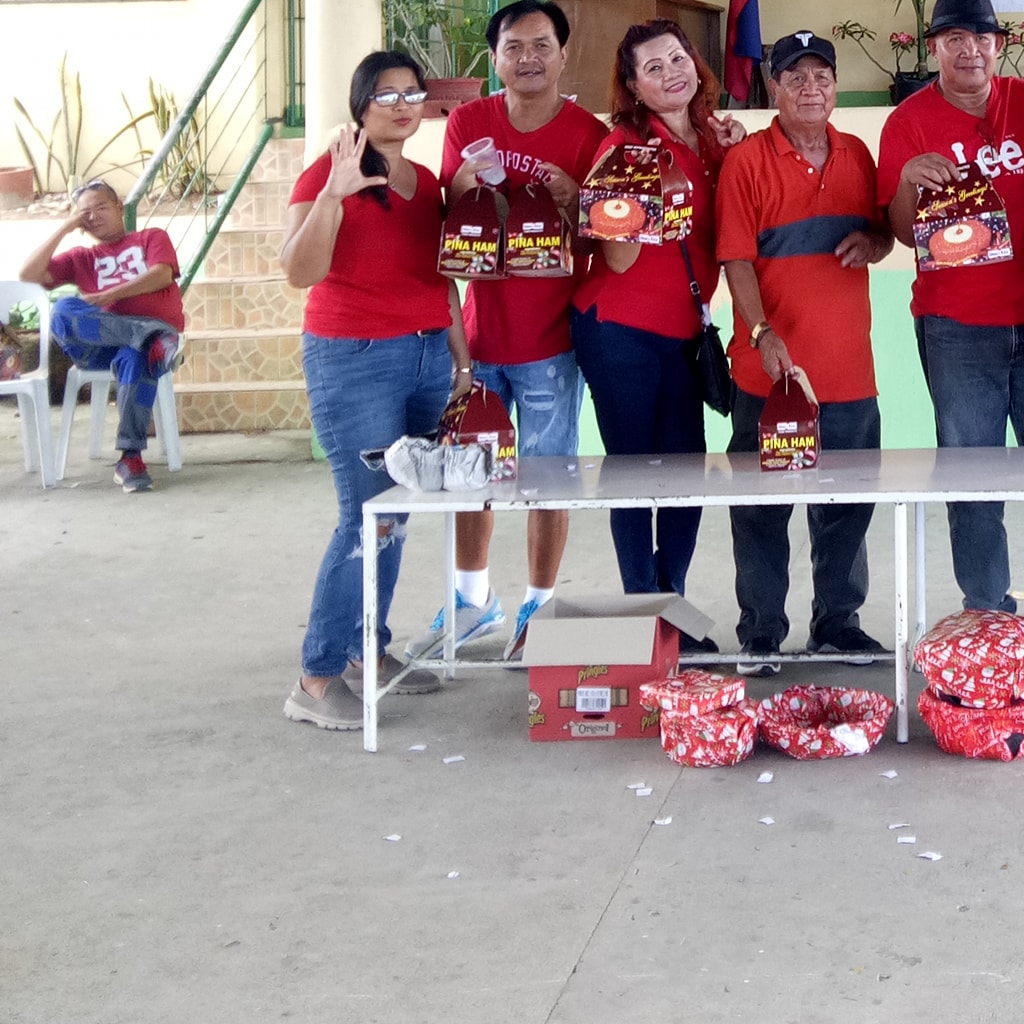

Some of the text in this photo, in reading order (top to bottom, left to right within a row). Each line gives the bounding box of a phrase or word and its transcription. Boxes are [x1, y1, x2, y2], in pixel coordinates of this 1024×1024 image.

[472, 241, 497, 252] HAM
[536, 236, 561, 247] HAM
[791, 436, 815, 447] HAM
